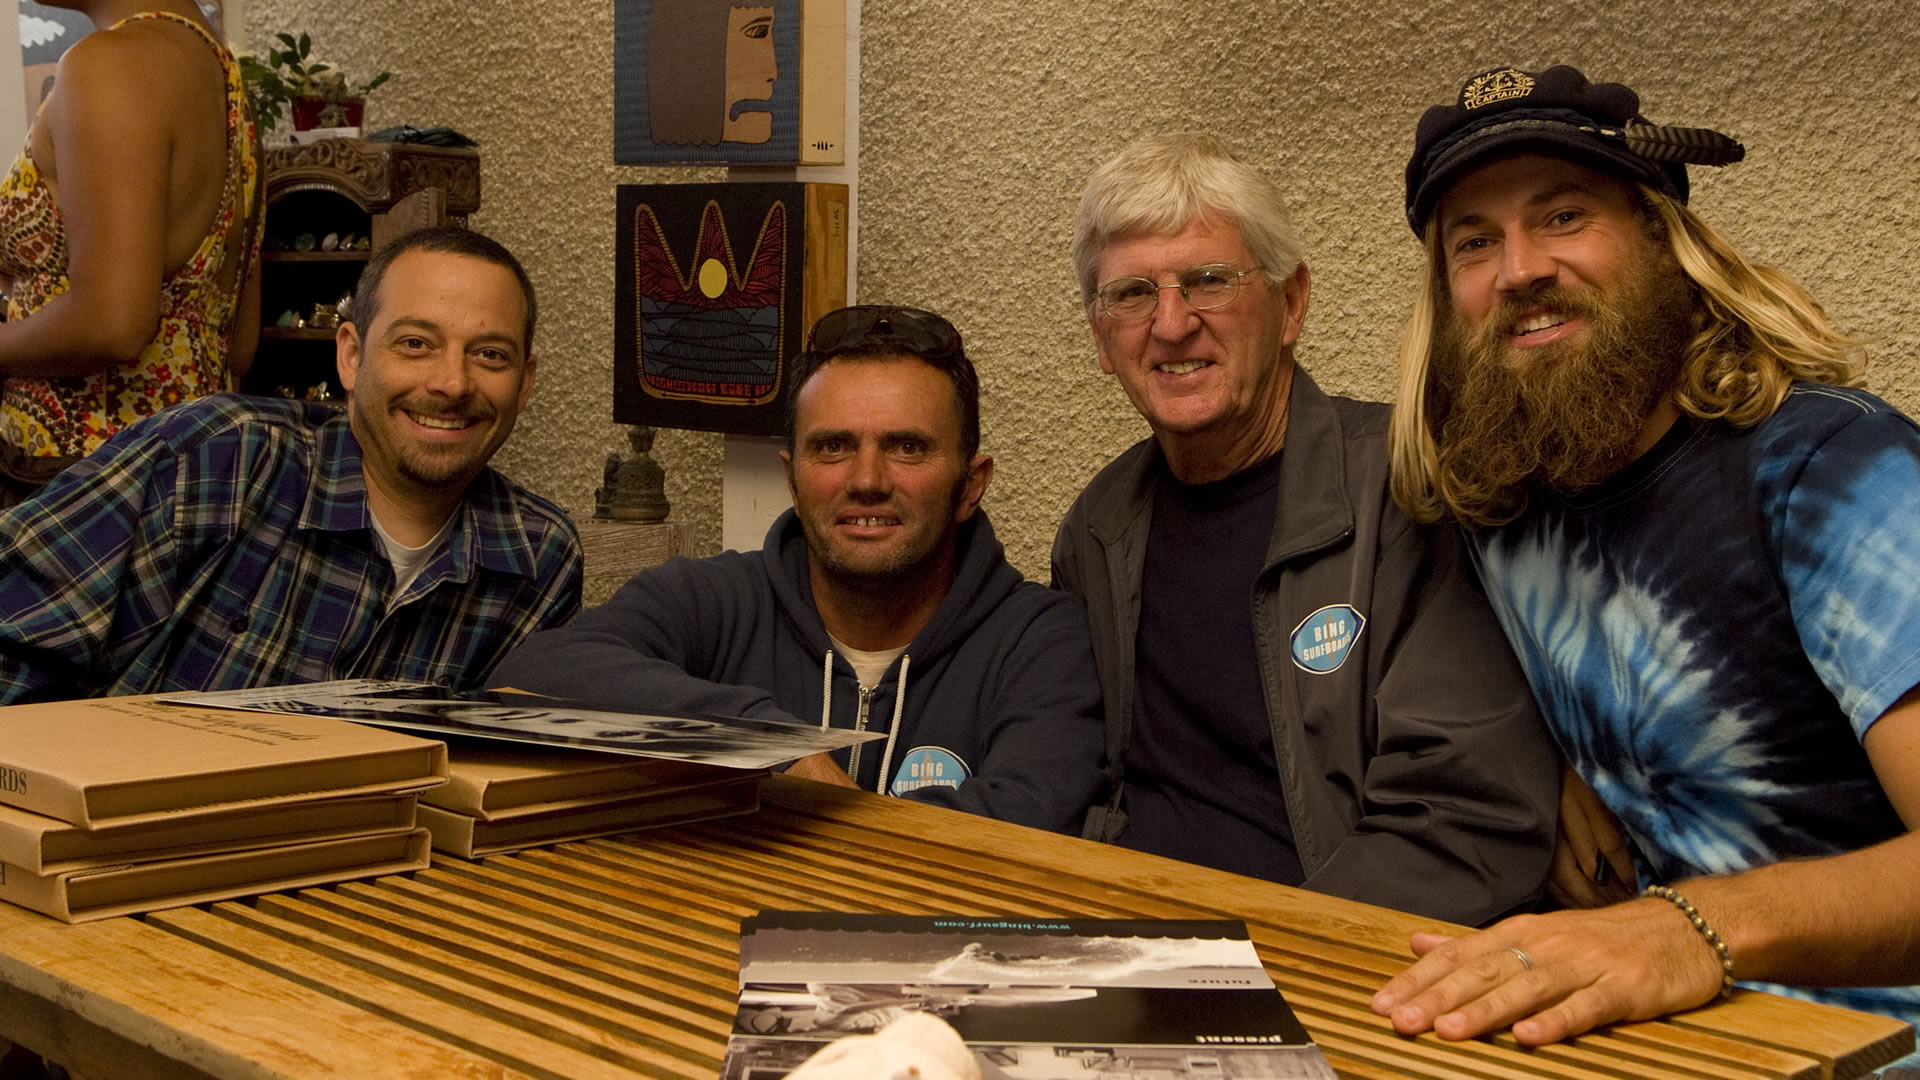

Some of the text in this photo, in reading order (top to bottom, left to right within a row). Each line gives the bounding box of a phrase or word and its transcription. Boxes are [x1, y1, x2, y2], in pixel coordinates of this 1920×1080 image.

[1475, 89, 1521, 106] CAPTAIN
[1313, 619, 1346, 643] BING
[911, 761, 944, 778] BING
[934, 920, 1071, 930] www.bingsurf.com
[1195, 1034, 1282, 1044] present
